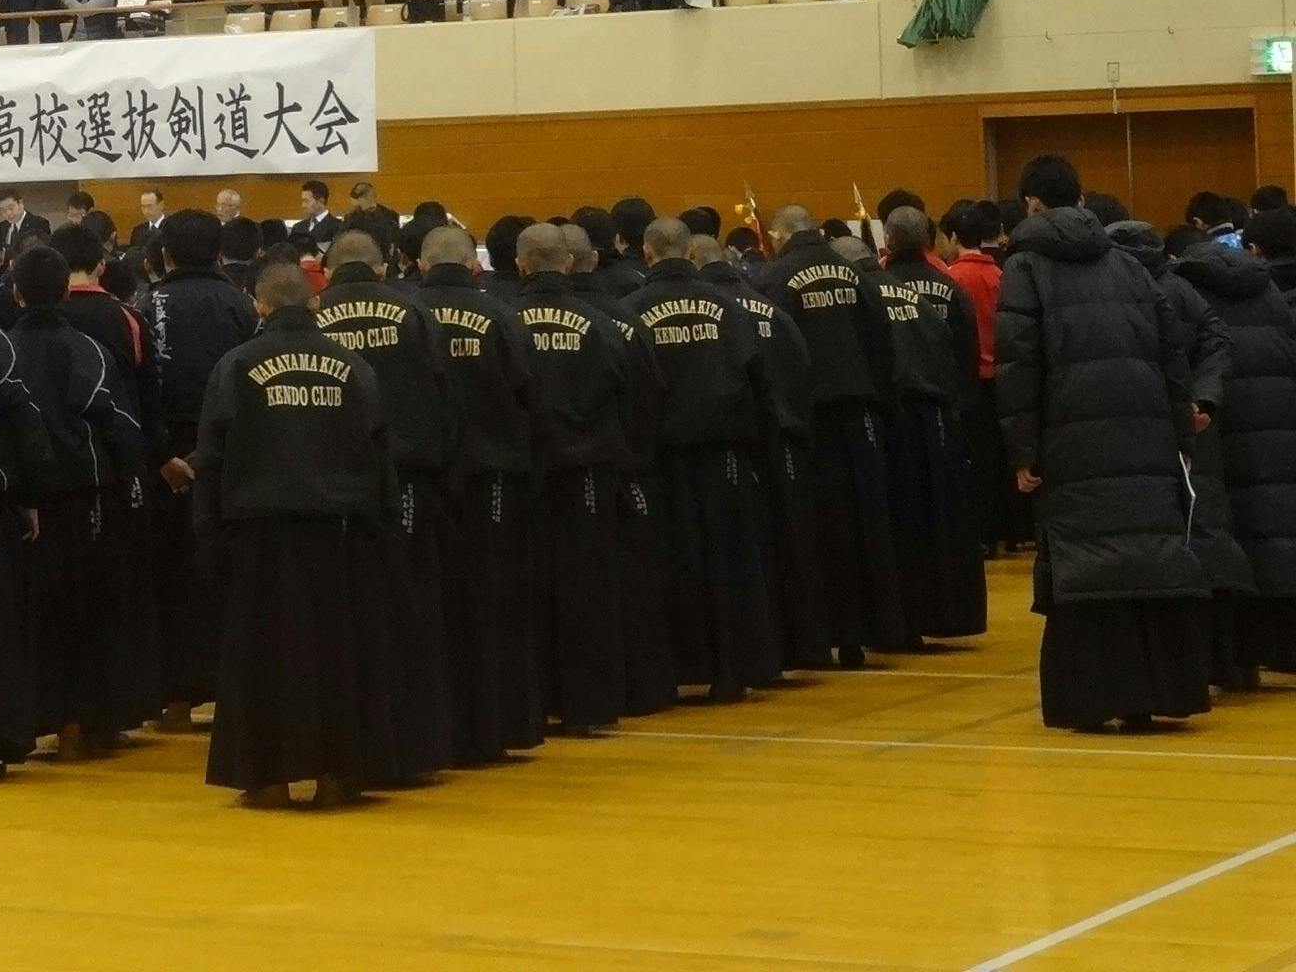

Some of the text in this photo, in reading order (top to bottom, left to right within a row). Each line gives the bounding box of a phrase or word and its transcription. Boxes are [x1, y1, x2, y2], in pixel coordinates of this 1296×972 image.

[801, 287, 857, 309] KENDO CLUB
[896, 286, 919, 304] KITA
[316, 301, 374, 328] AKAYAMA
[375, 302, 406, 324] KITA
[698, 300, 724, 322] KITA
[749, 299, 775, 319] KITA
[896, 305, 919, 321] CLUB
[461, 311, 492, 335] KITA
[561, 311, 592, 335] KITA
[654, 323, 718, 345] KENDO CLUB
[367, 326, 399, 347] CLUB
[450, 338, 480, 357] CLUB
[552, 332, 581, 351] CLUB
[248, 353, 352, 386] WAKAYAMA KITA
[266, 385, 342, 407] KENDO CLUB
